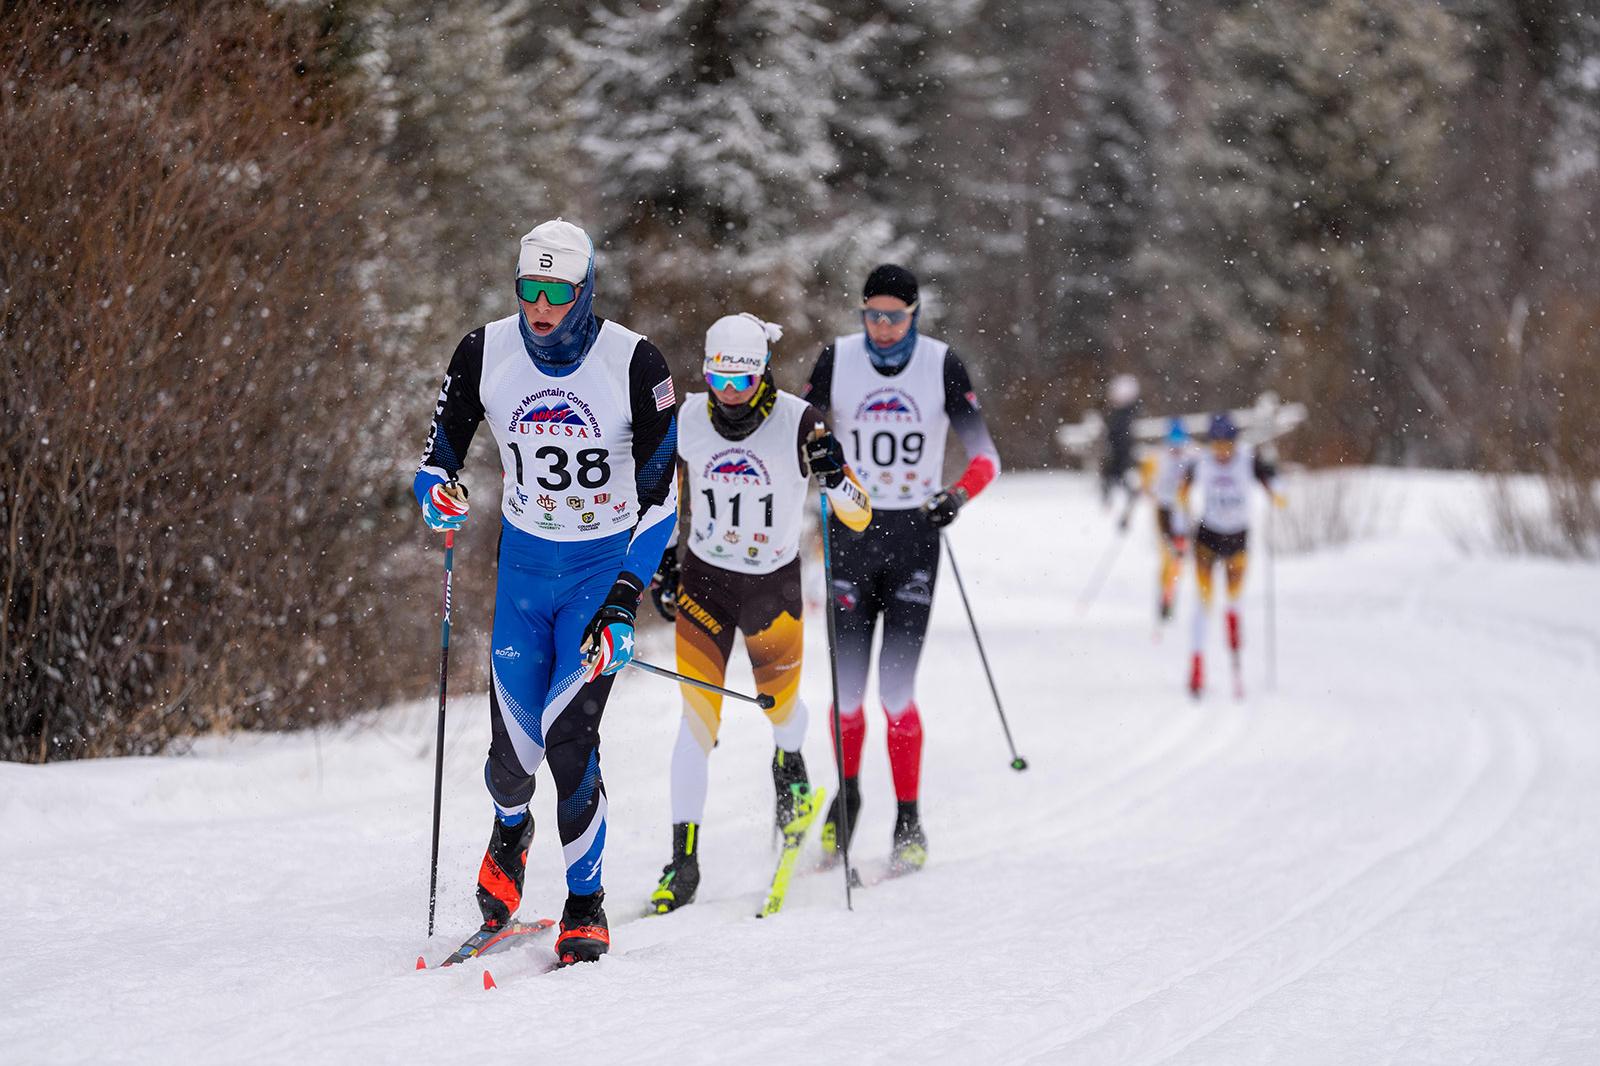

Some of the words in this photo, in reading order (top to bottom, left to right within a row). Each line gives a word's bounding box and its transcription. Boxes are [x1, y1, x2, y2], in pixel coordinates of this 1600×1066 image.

[509, 405, 525, 432] Rocky
[521, 388, 565, 407] Mountain
[566, 392, 602, 438] Conference
[519, 423, 588, 438] USCSA
[507, 442, 611, 491] 138
[851, 430, 925, 466] 109
[702, 488, 773, 527] 111
